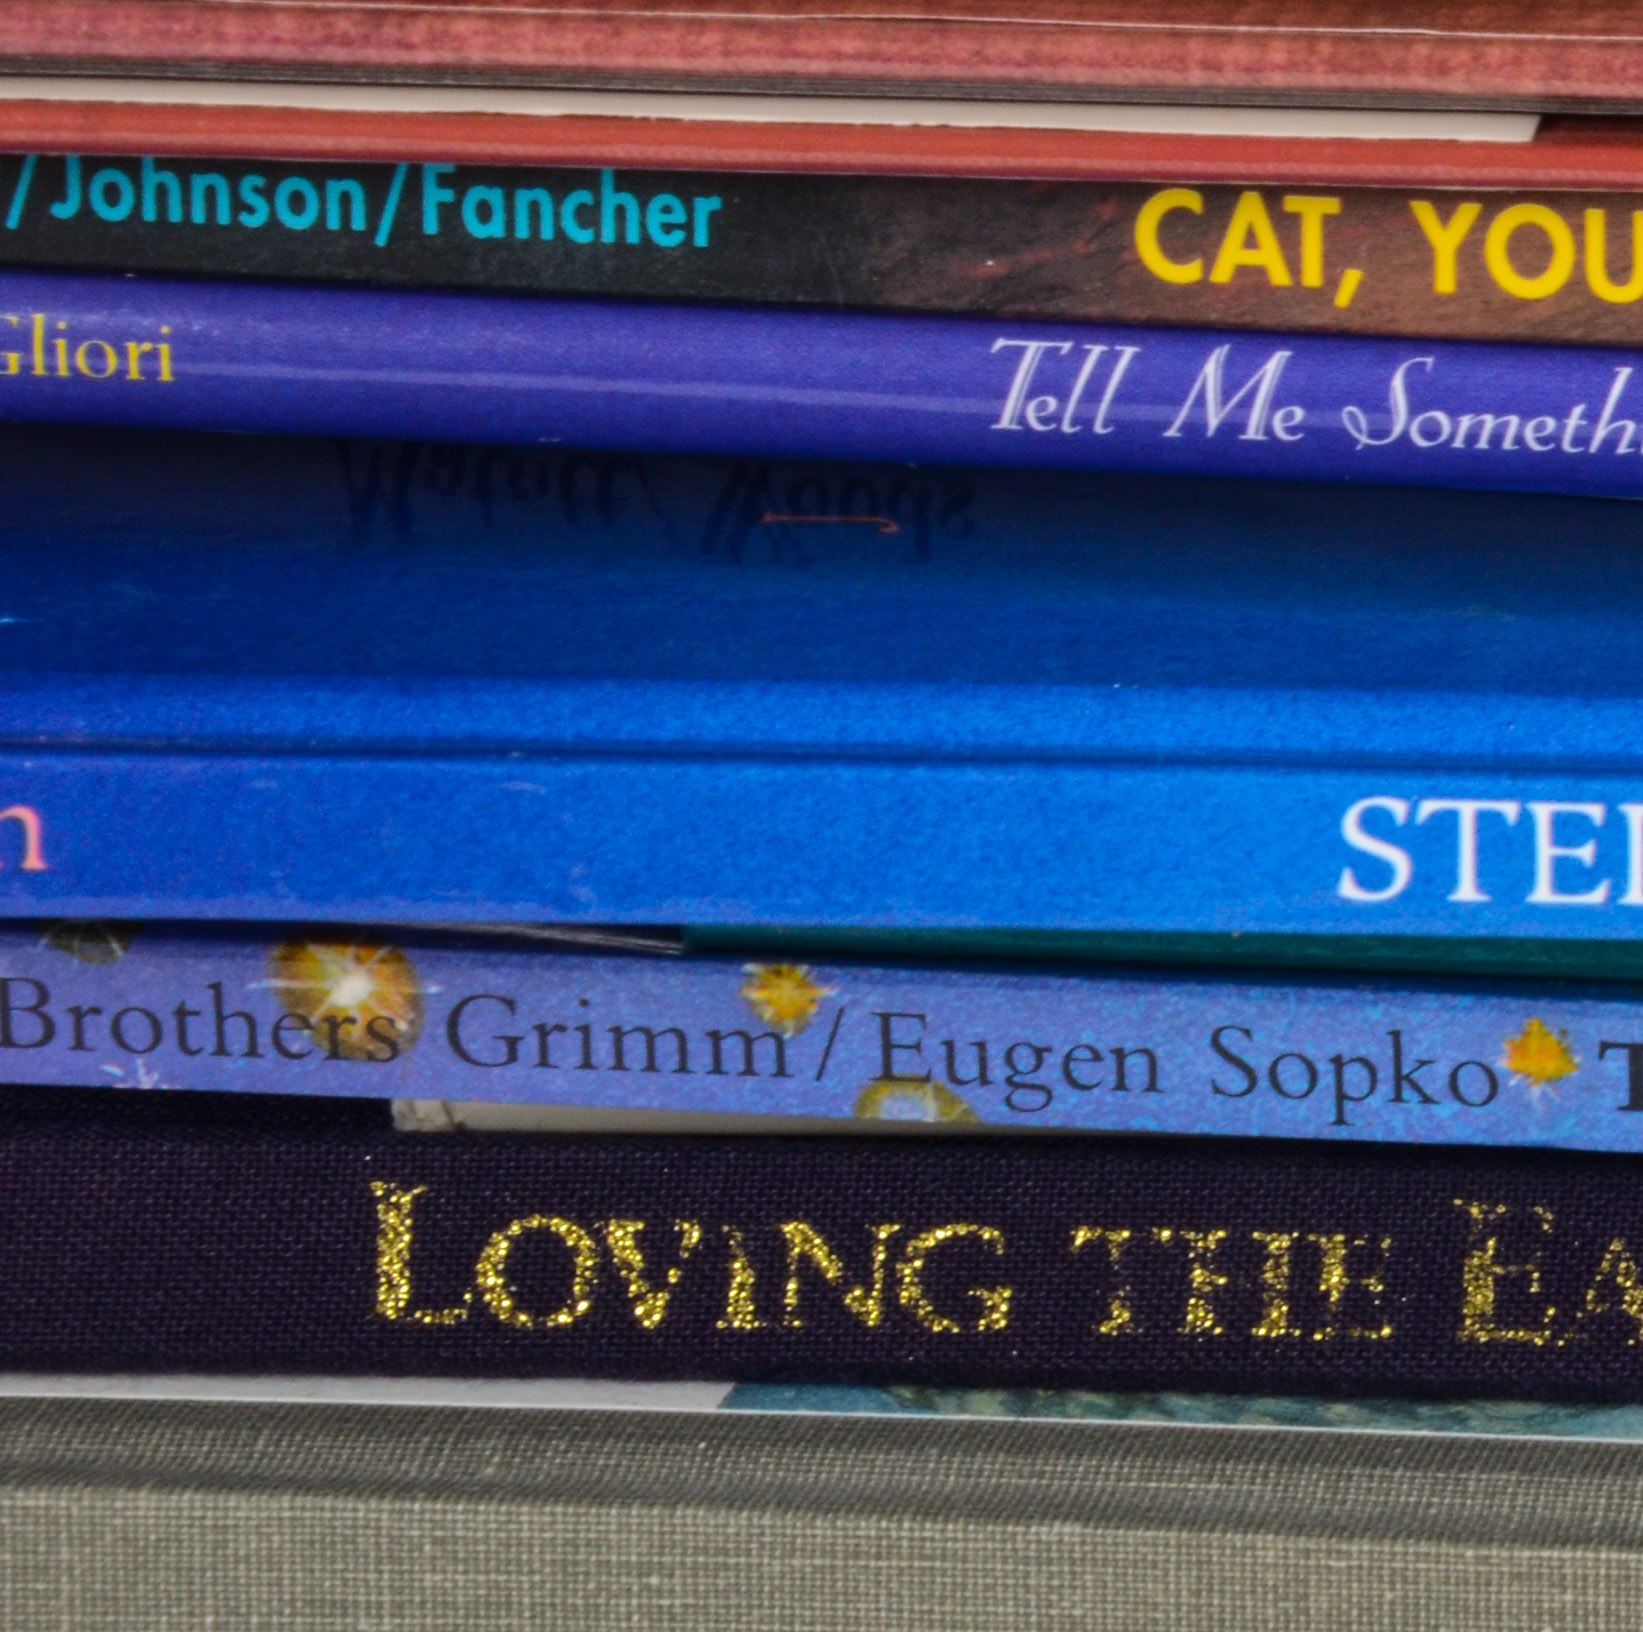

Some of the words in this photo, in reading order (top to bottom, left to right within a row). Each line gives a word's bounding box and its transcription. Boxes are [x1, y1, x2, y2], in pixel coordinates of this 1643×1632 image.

[1134, 188, 1364, 309] CAT,
[990, 338, 1141, 436] Tell
[1163, 343, 1306, 443] Me
[0, 976, 400, 1064] Brothers
[1210, 1023, 1501, 1126] Sopko
[370, 1180, 1007, 1340] LOVING
[1072, 1223, 1392, 1344] THE
